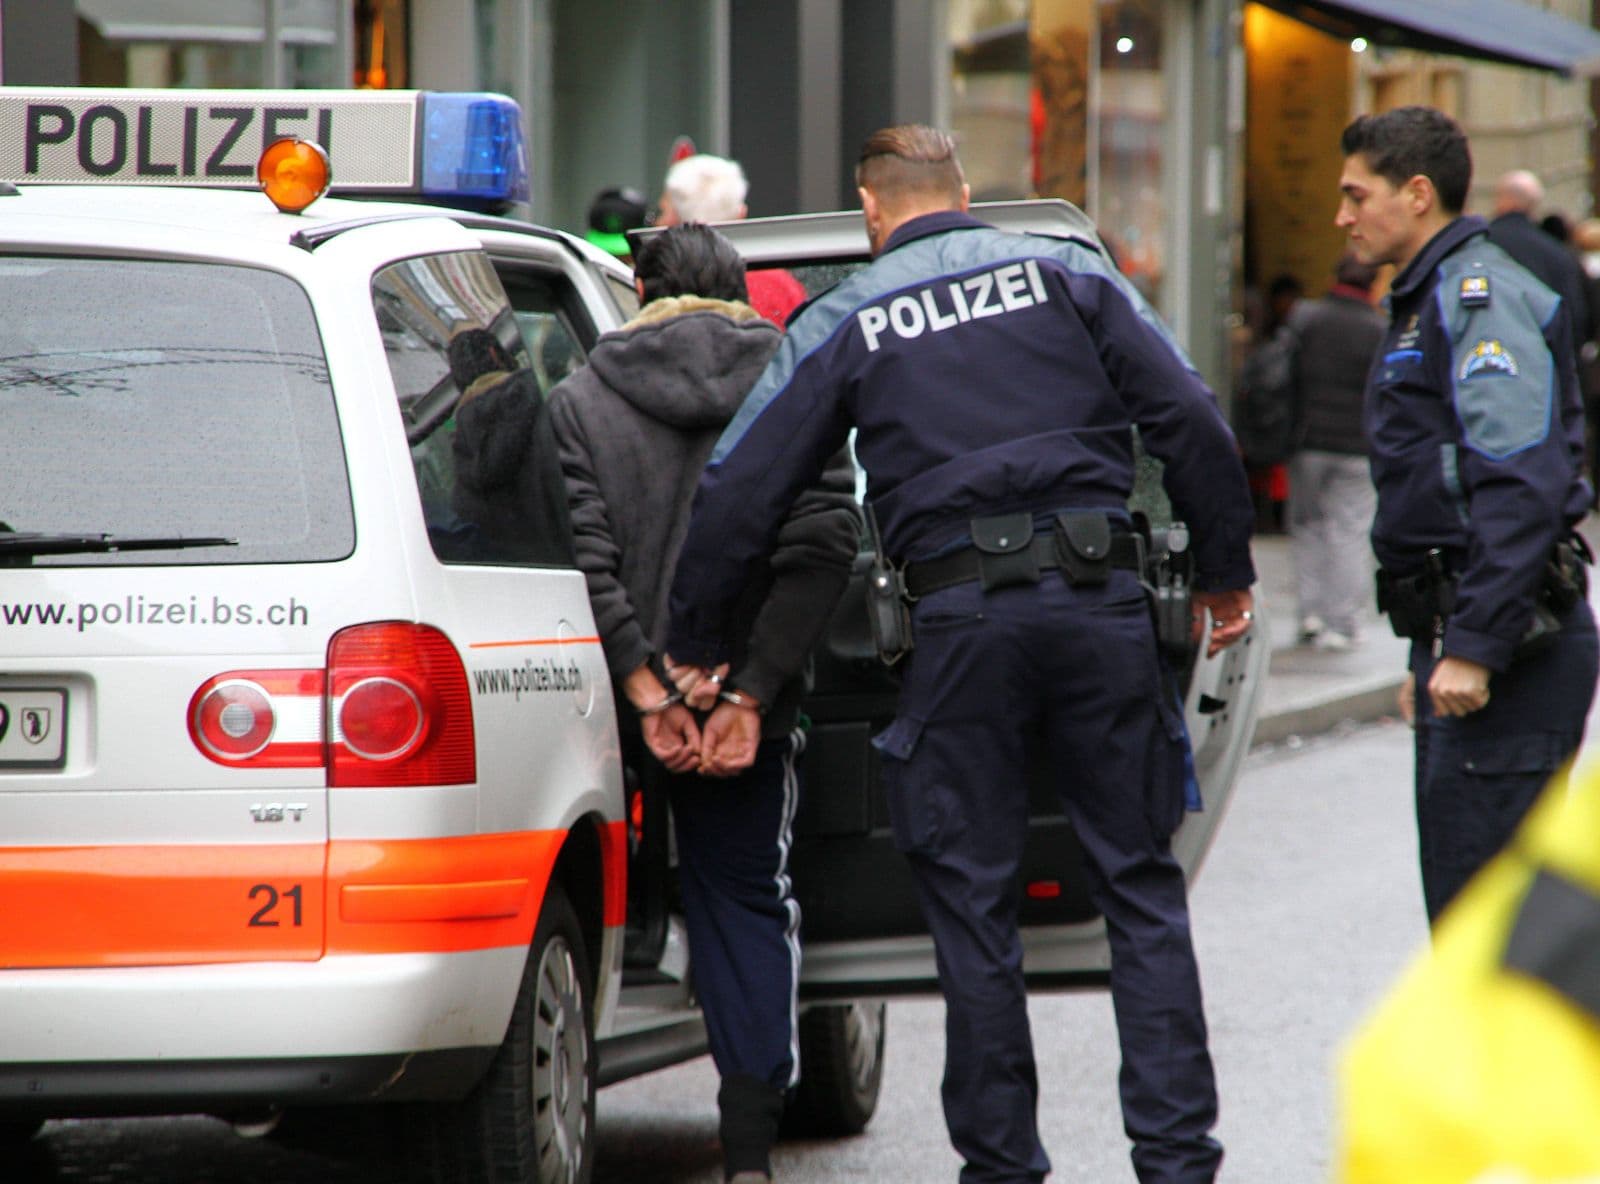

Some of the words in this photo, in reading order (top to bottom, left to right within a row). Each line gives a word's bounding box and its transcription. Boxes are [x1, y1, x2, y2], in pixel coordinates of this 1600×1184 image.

[857, 259, 1048, 352] POLIZEI
[473, 657, 582, 702] www.polizei.bs.ch
[248, 884, 302, 927] 21
